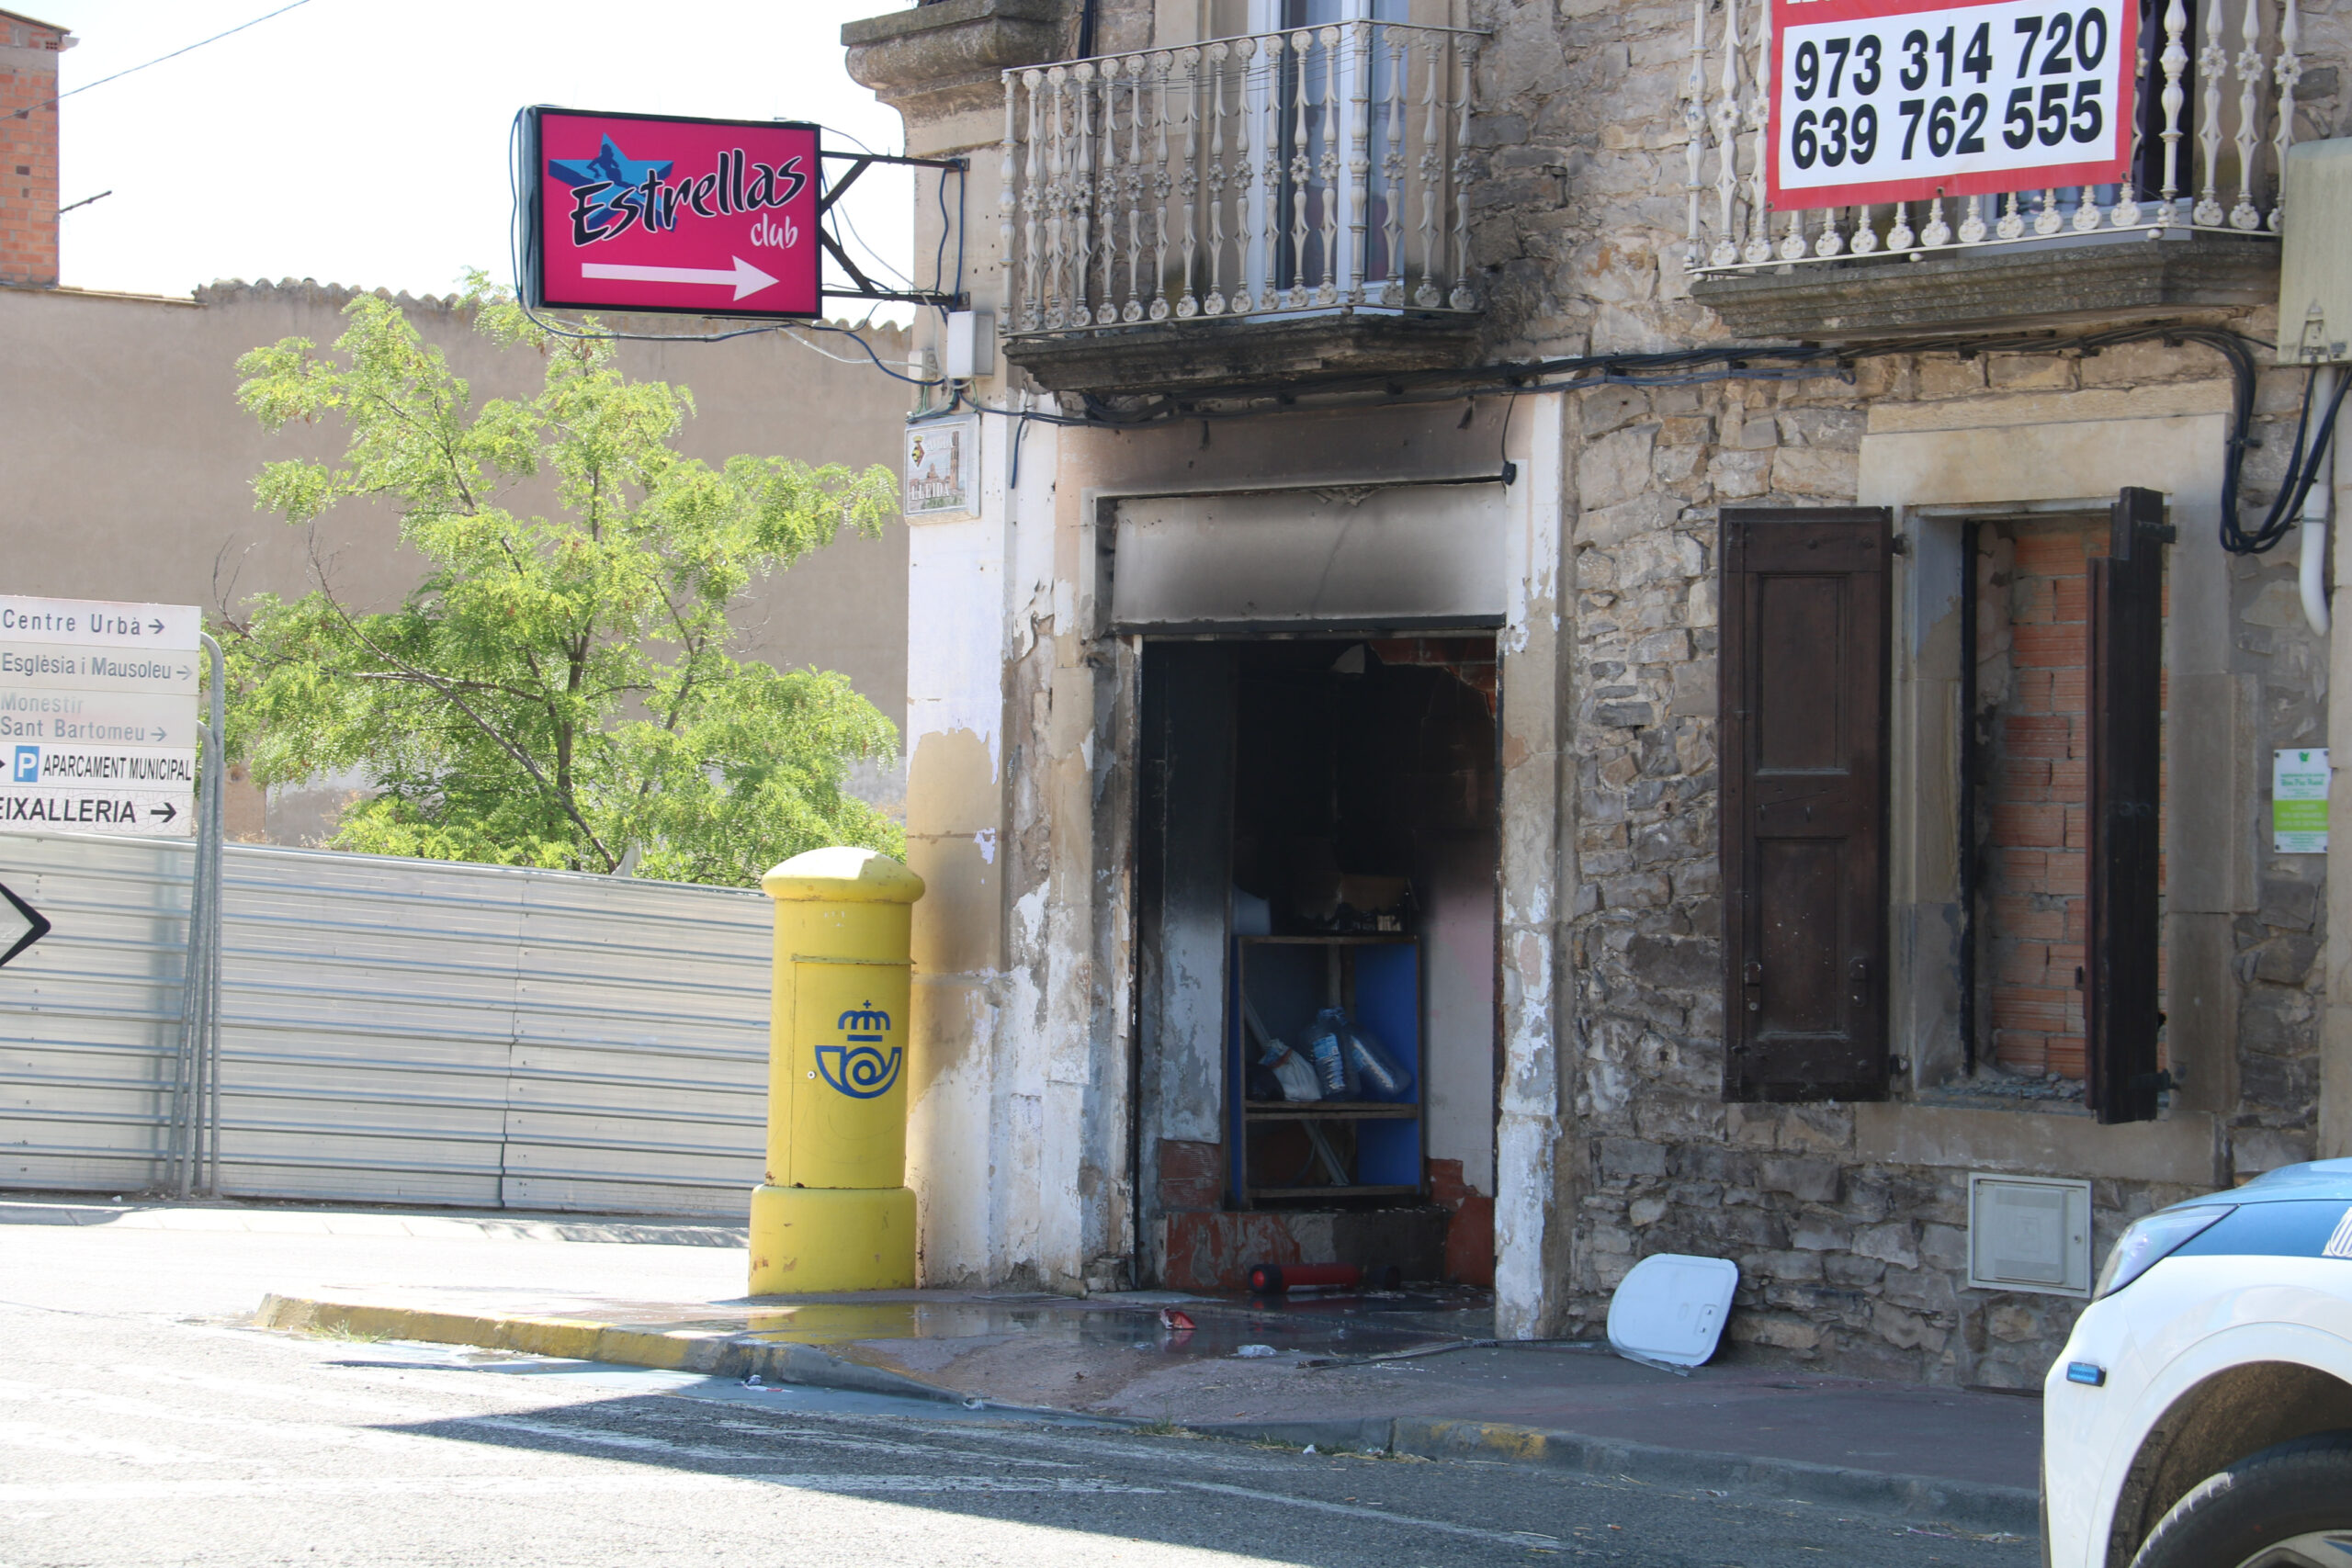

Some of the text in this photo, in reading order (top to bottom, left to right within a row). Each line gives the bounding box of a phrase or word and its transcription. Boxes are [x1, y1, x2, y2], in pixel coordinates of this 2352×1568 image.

[1793, 7, 2108, 101] 973 314 720
[1792, 79, 2103, 170] 639 762 555
[570, 148, 807, 248] Estrellas
[750, 213, 798, 249] club
[910, 482, 950, 501] LLEIDA
[3, 609, 141, 636] Centre Urbà
[81, 657, 85, 675] i
[92, 657, 172, 679] Mausoleu
[0, 692, 84, 715] Monestir
[0, 716, 144, 741] Sant Bartomeu
[17, 752, 192, 781] P APARCAMENT MUNICIPAL
[0, 796, 137, 823] IXALLERIA
